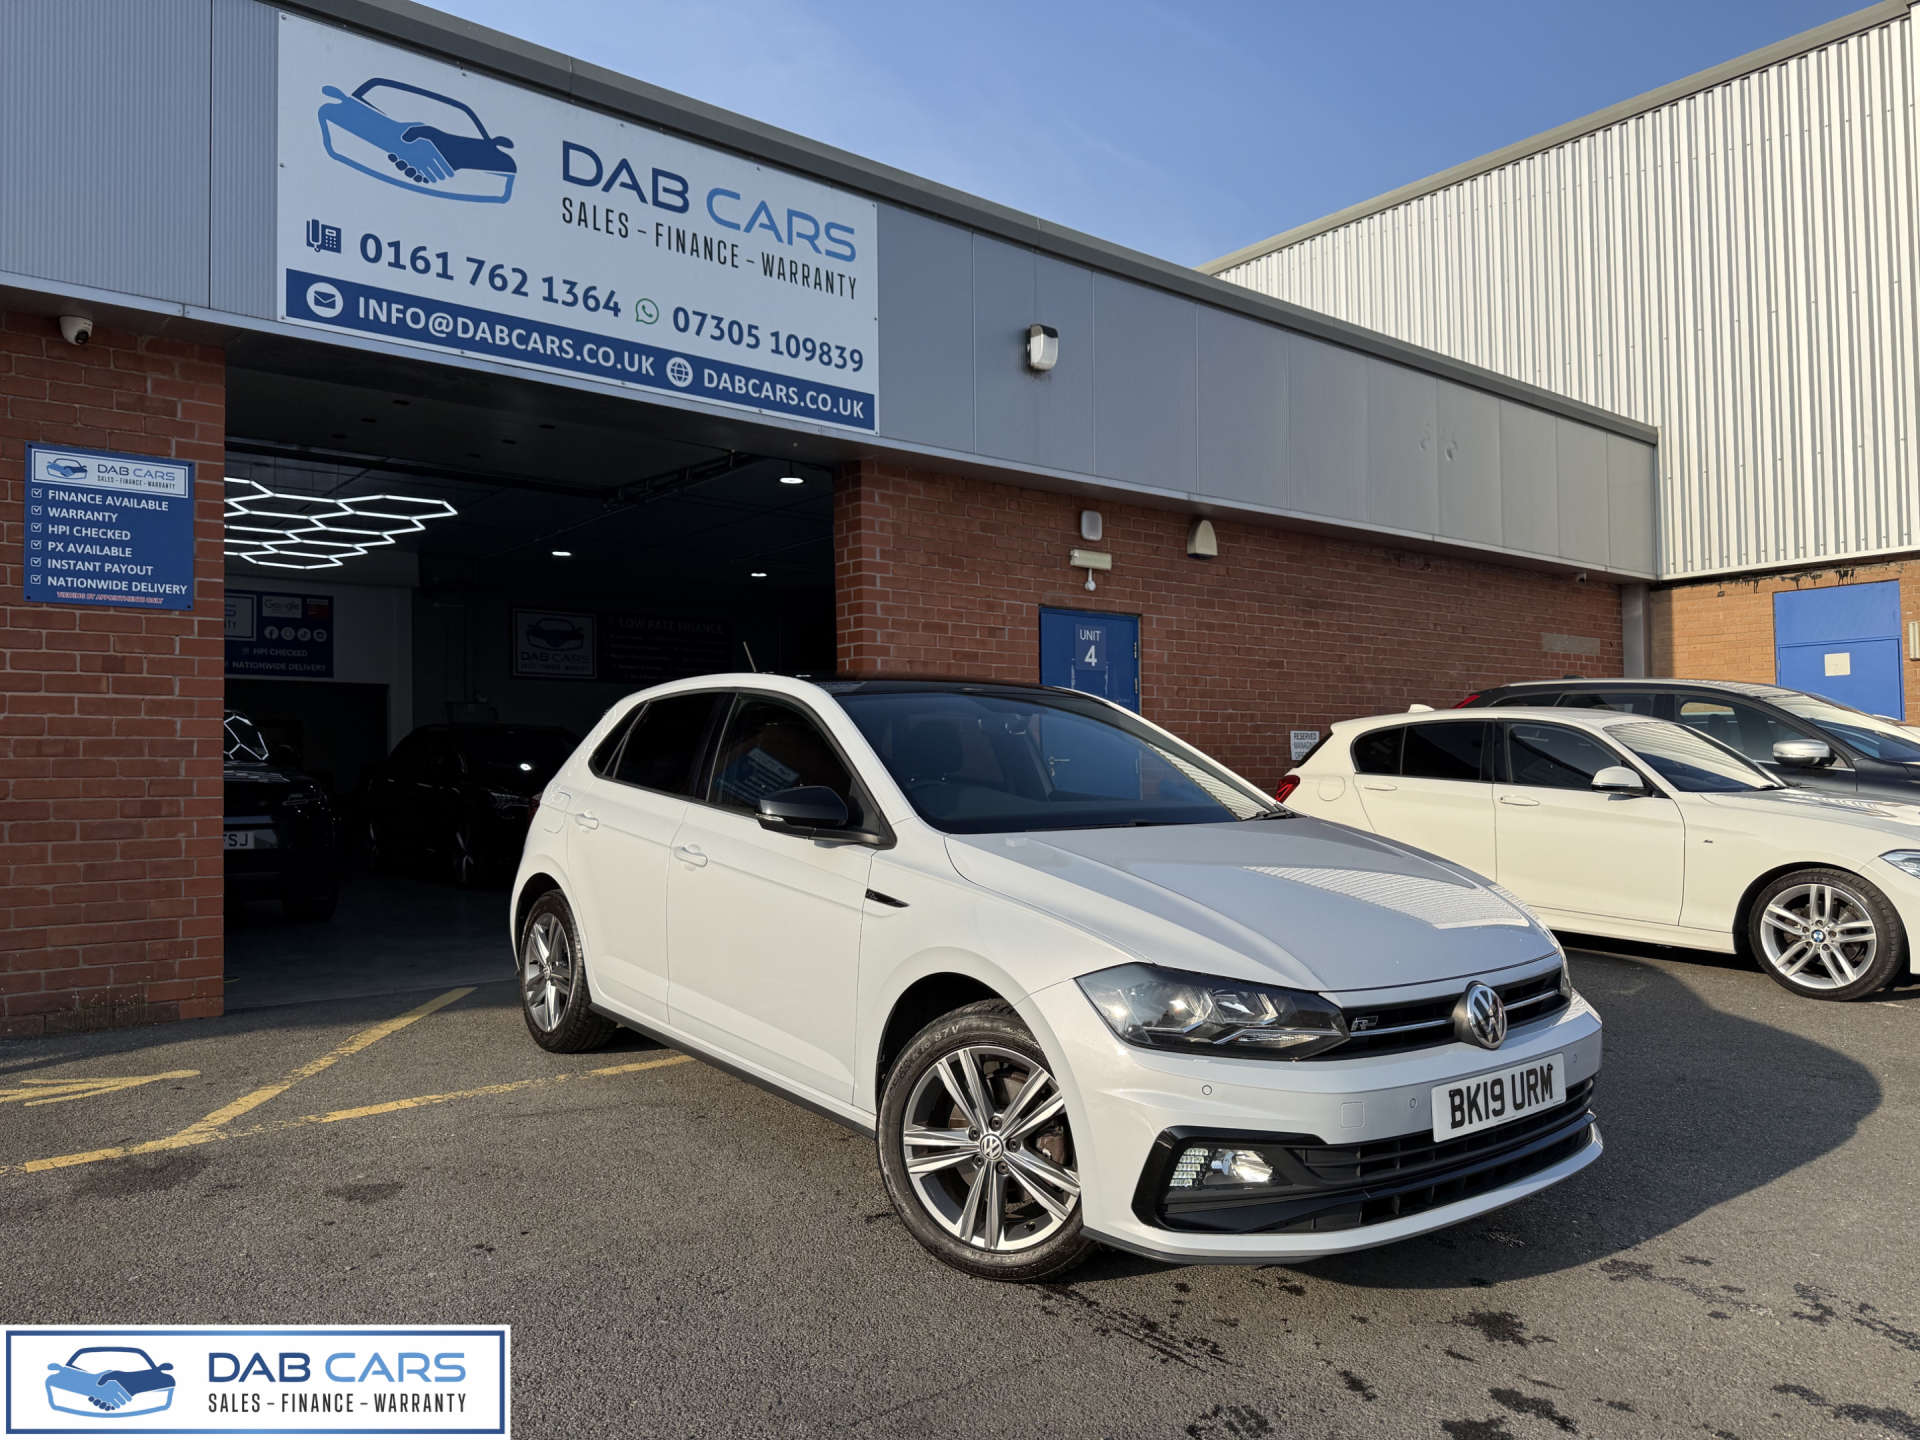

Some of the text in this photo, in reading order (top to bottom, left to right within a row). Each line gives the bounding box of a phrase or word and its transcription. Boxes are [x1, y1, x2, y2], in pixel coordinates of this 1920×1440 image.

[562, 140, 857, 263] DAB CARS
[561, 197, 629, 239] SALES
[655, 223, 740, 270] FINANCE
[761, 251, 857, 301] WARRANTY
[360, 232, 621, 318] 0161 762 1364
[358, 296, 655, 378] INFO@DABCARS.CO.UK
[673, 305, 864, 373] 07305 109839
[703, 368, 864, 420] DABCARS.CO.UK
[97, 464, 176, 481] DAB CARS
[120, 477, 143, 487] FINANCE
[147, 481, 176, 490] WARRANTY
[48, 490, 169, 511] FINANCE AVAILABLE
[48, 507, 118, 522] WARRANTY
[48, 524, 131, 541] HPI CHECKED
[48, 541, 132, 557] PX AVAILABLE
[47, 558, 153, 576] INSTANT PAYOUT
[47, 576, 188, 595] NATIONWIDE DELIVERY
[1079, 629, 1102, 641] UNIT
[1084, 645, 1098, 667] 4
[1448, 1064, 1553, 1129] BK19 URM
